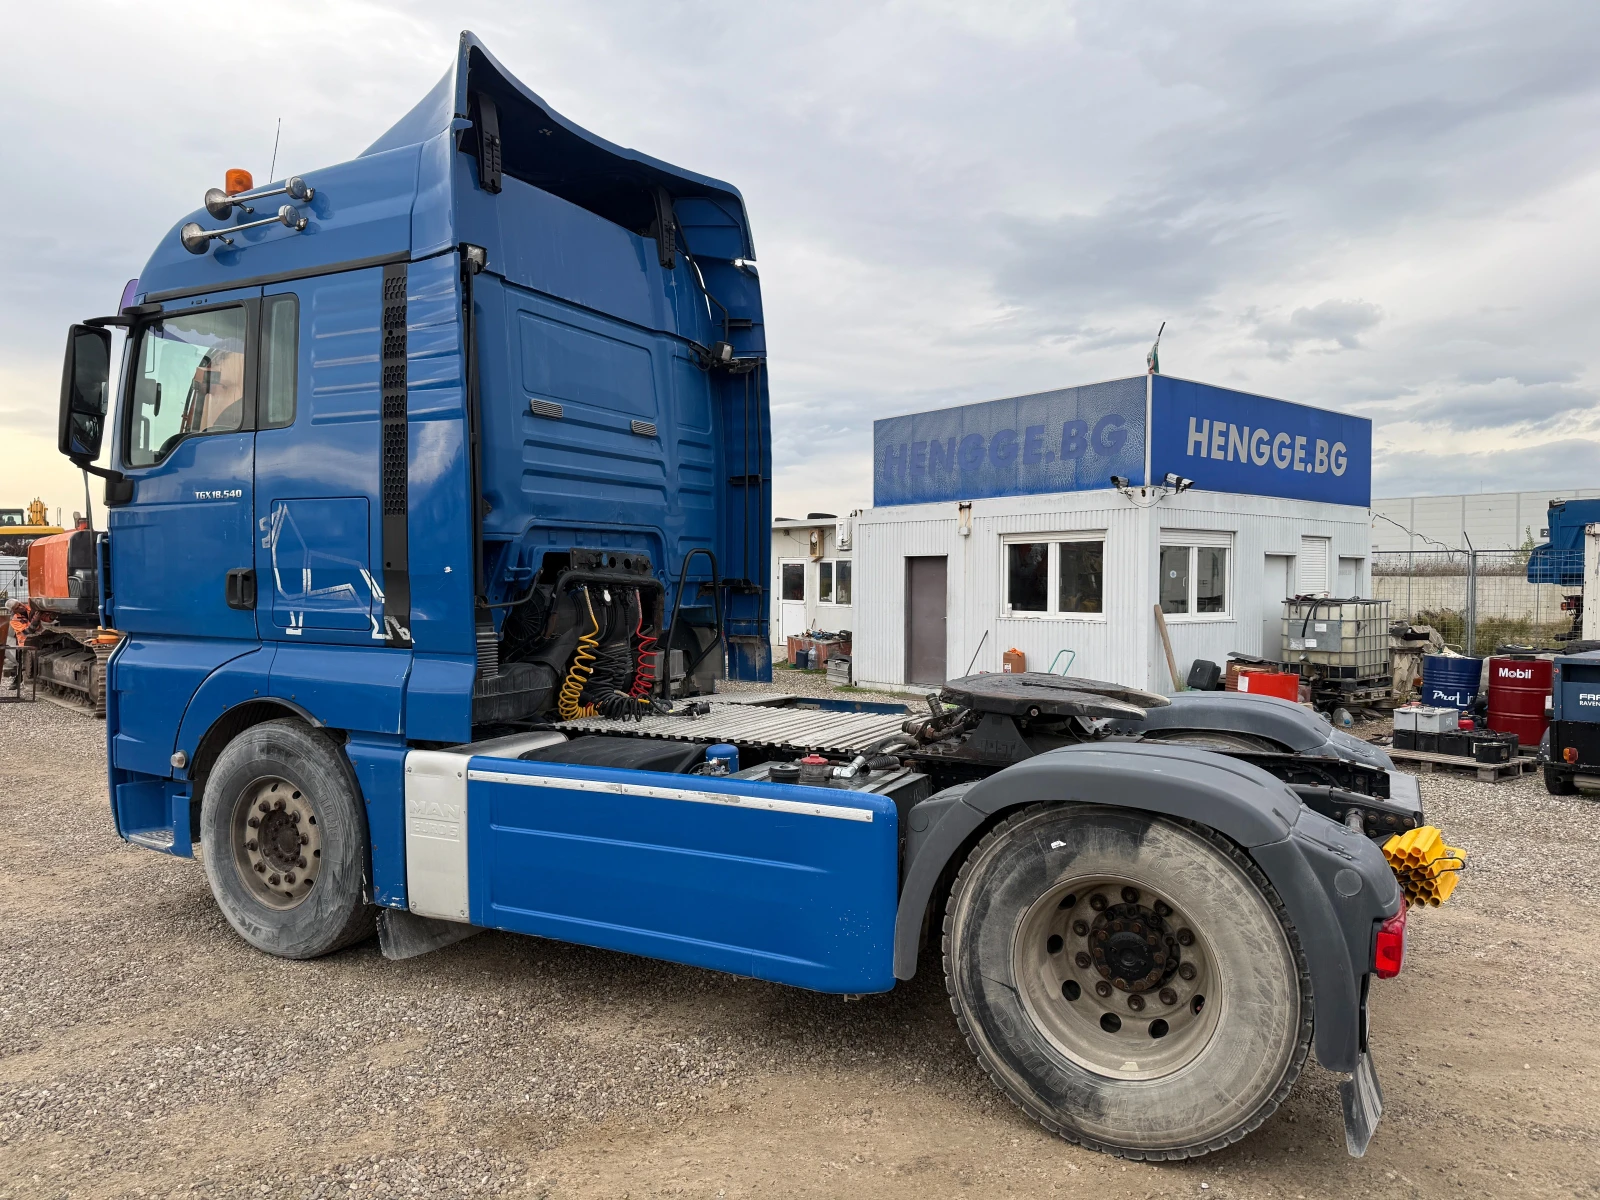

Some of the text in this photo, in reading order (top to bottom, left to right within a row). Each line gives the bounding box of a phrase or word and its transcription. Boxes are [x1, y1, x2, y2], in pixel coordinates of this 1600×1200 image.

[883, 413, 1128, 481] HENGGE.BG
[1186, 416, 1348, 477] HENGGE.BG
[1498, 667, 1532, 679] Mobil
[1432, 690, 1475, 706] ProLin
[409, 799, 460, 820] MAN
[412, 820, 458, 838] EURO 5
